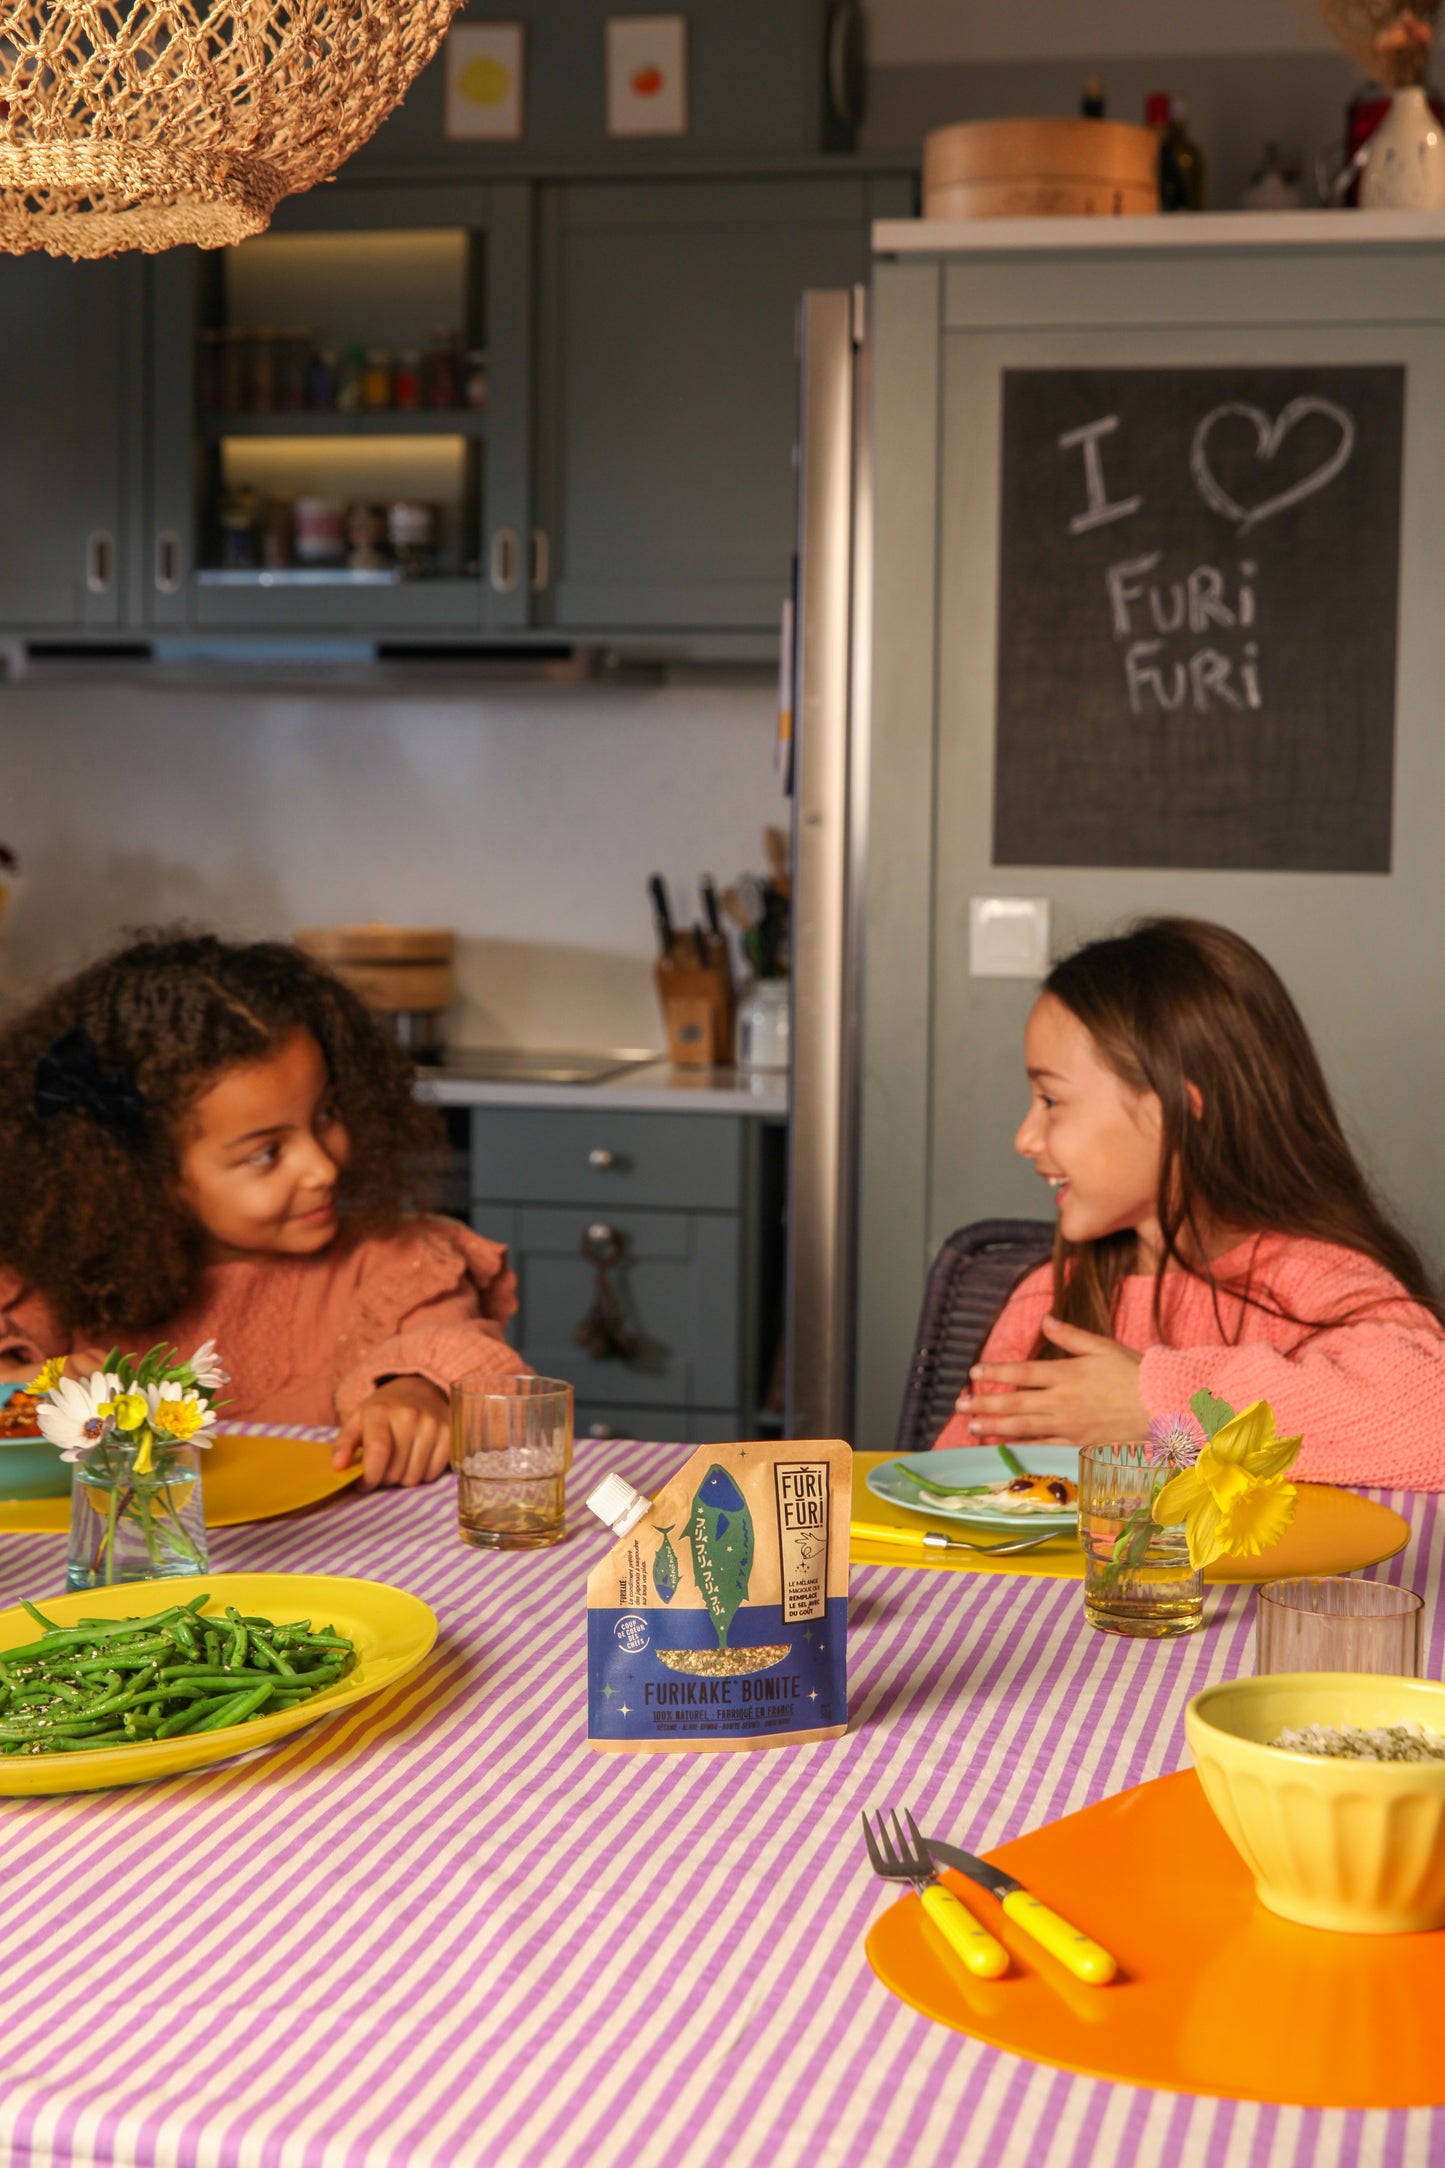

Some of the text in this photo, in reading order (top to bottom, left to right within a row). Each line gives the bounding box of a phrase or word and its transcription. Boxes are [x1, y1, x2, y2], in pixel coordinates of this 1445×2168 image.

[1058, 414, 1142, 534] I
[742, 1675, 801, 1702] BONITE
[675, 1709, 708, 1720] NATUREL
[717, 1704, 752, 1720] FABRIQUÉ
[755, 1706, 765, 1718] EN
[768, 1703, 794, 1716] FRANCE
